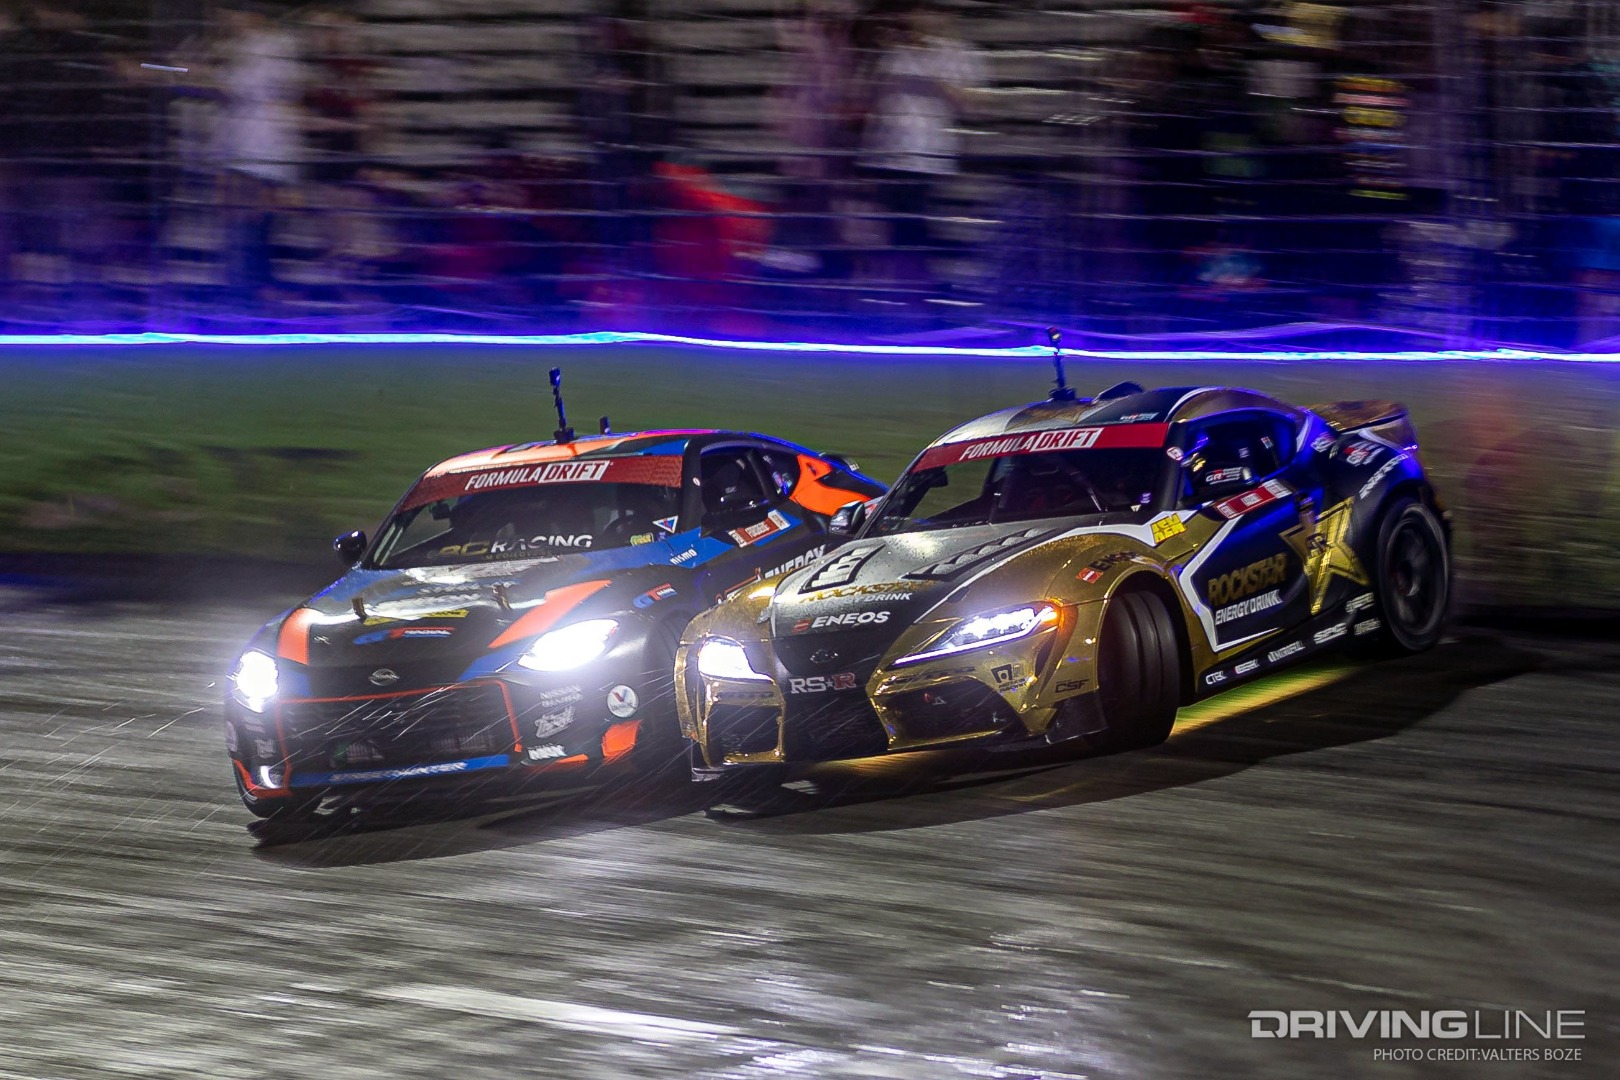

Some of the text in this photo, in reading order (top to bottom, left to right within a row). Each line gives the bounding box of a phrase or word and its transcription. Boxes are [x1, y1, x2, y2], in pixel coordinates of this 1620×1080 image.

[959, 427, 1104, 461] FORMULA DRIFT
[464, 460, 610, 491] FORMULA DRIFT
[1208, 553, 1287, 605] ROCKSTAR
[864, 592, 913, 602] DRINK
[1215, 589, 1284, 625] ENERGY DRINK
[811, 611, 891, 628] ENEOS
[1055, 679, 1090, 693] CSF
